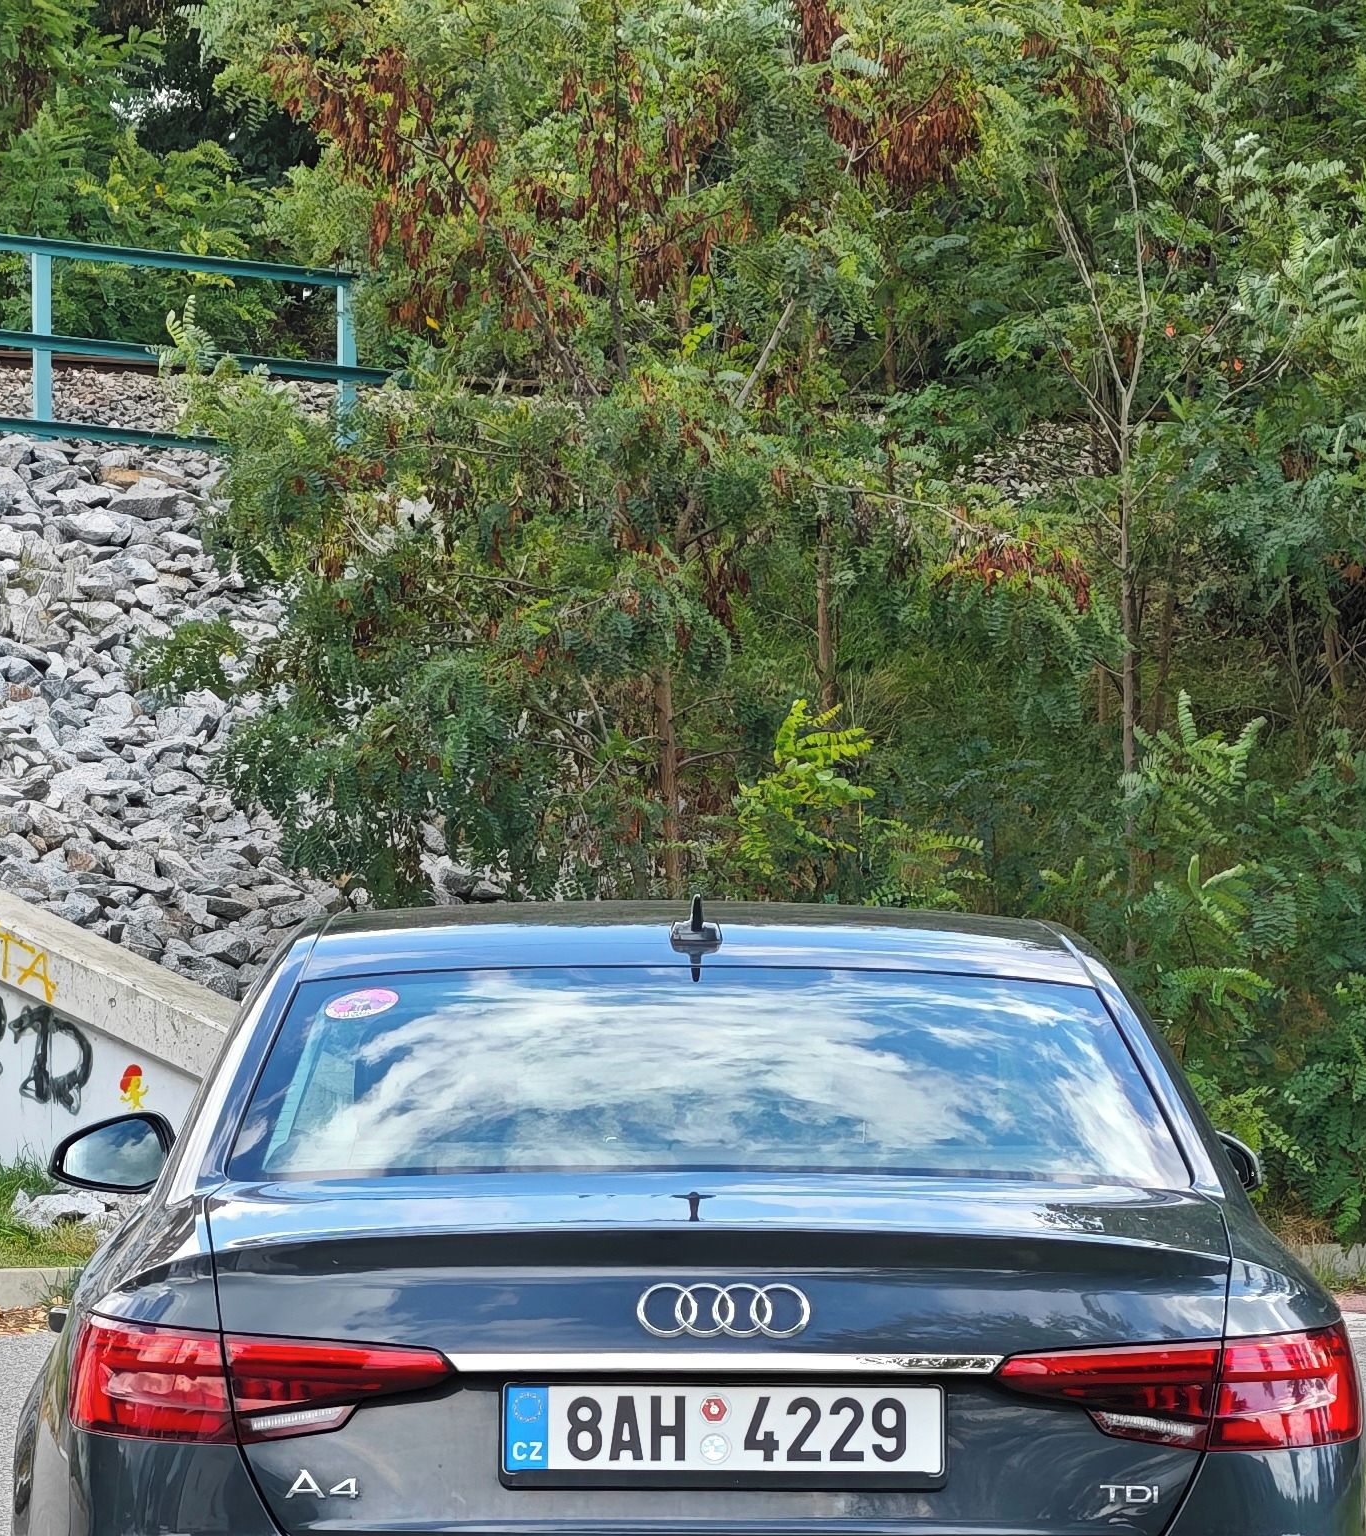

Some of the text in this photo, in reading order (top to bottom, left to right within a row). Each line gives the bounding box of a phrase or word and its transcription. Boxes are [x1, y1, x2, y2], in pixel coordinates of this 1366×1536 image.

[567, 1396, 907, 1462] 8AH 4229
[512, 1441, 543, 1461] CZ
[285, 1469, 359, 1499] A4
[1099, 1485, 1159, 1504] TDI
